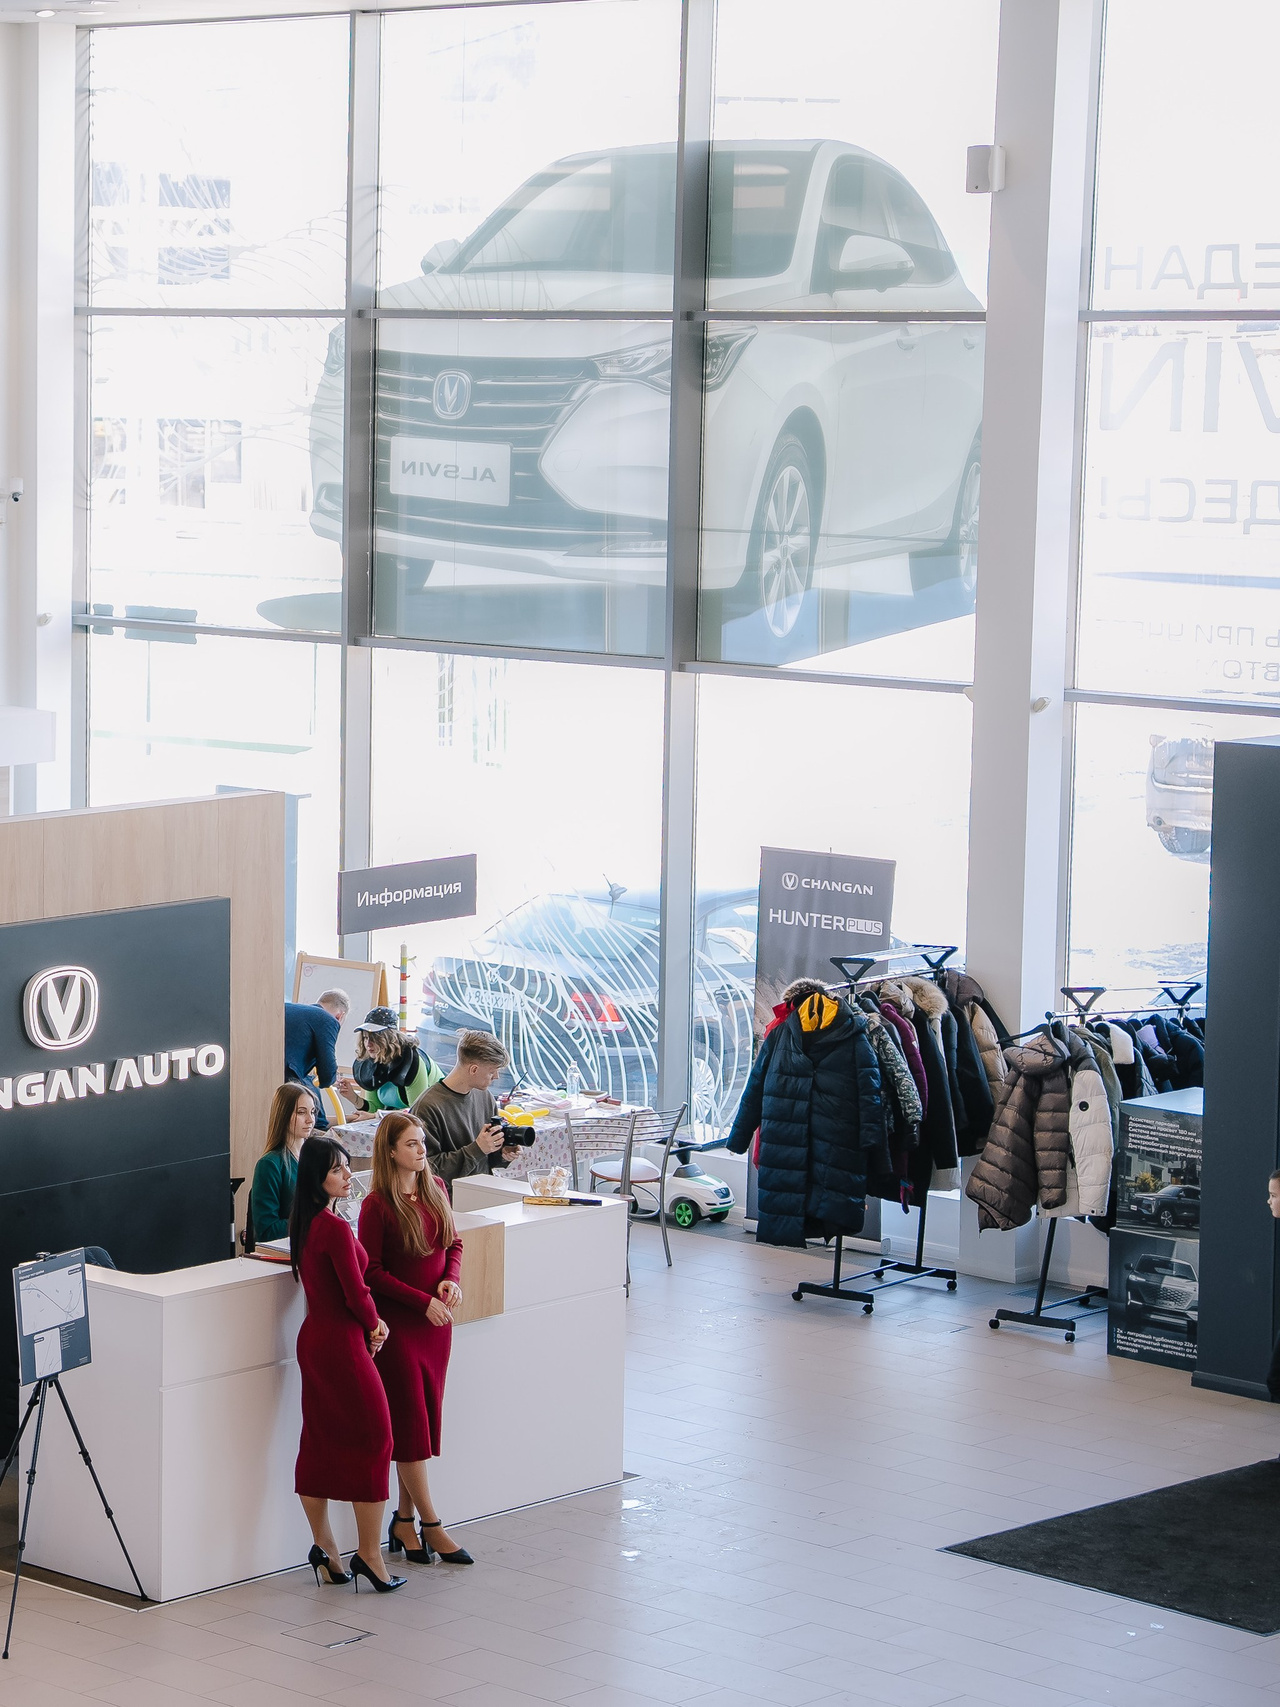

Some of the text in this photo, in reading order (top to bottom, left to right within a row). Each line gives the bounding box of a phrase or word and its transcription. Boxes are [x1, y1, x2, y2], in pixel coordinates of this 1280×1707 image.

[357, 882, 462, 907] Информация
[801, 878, 874, 896] CHANGAN
[769, 908, 882, 935] HUNTER PLUS
[109, 1044, 225, 1091] AUTO
